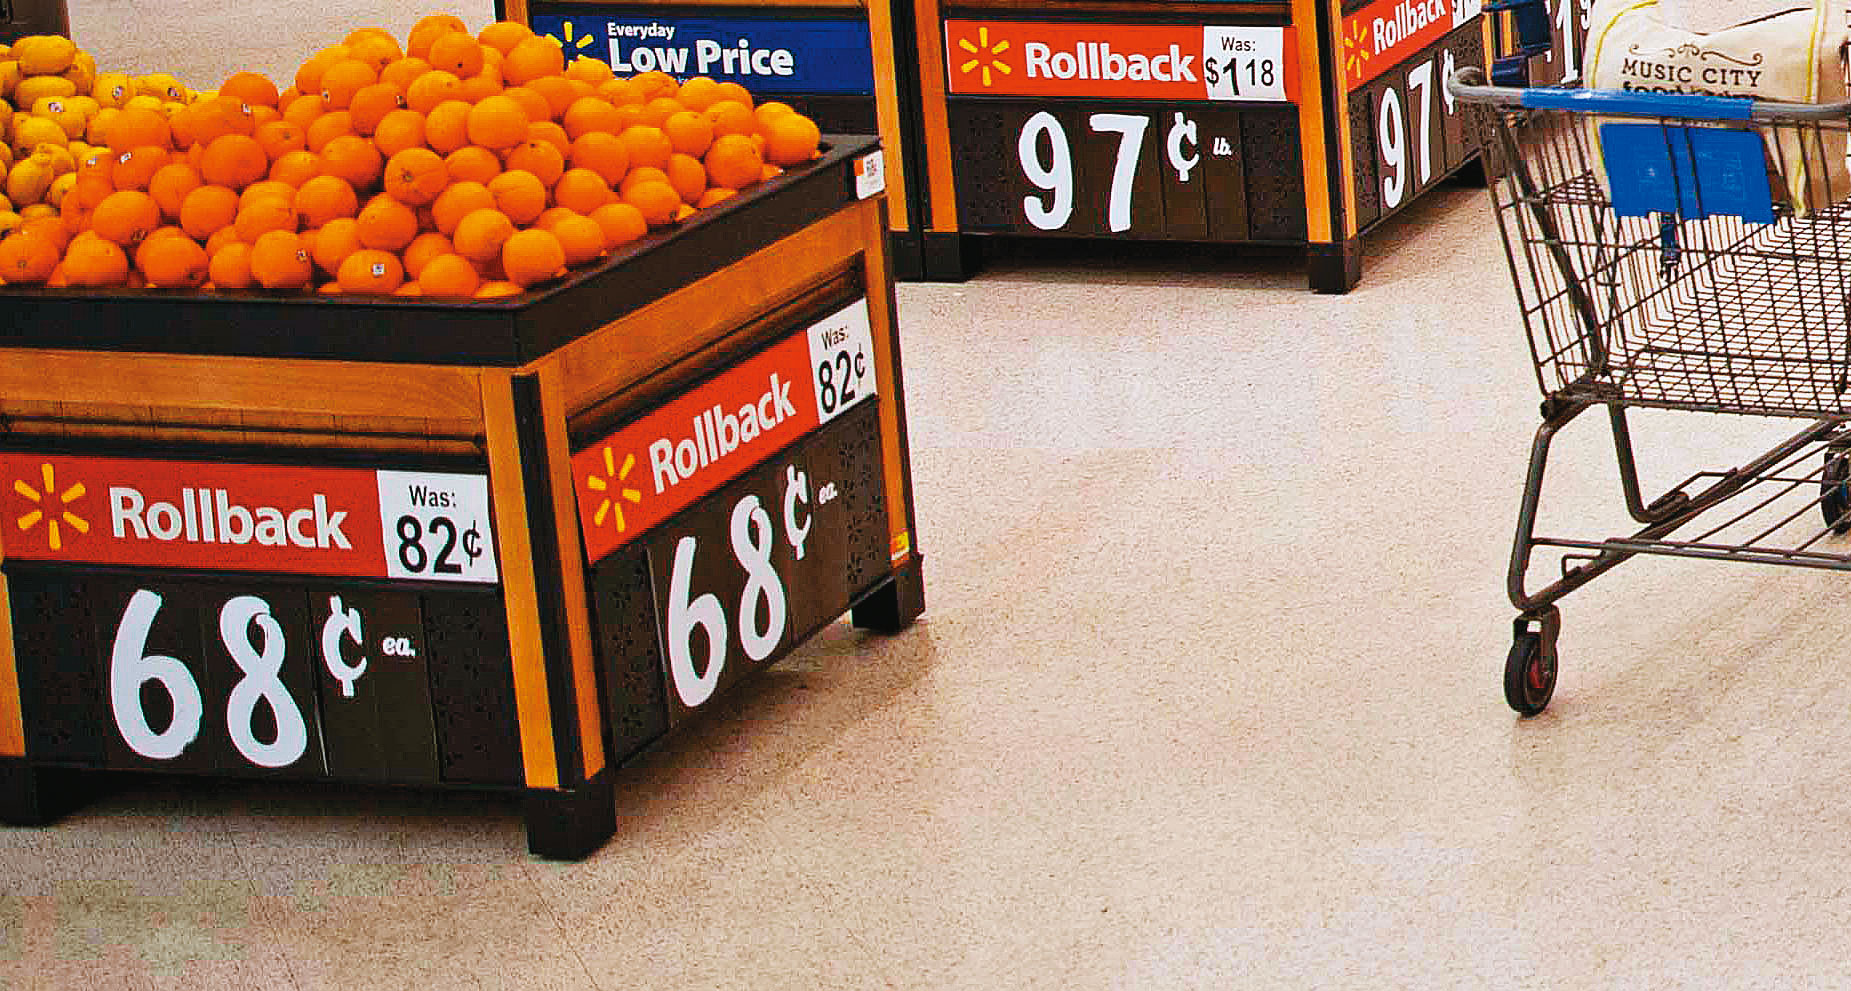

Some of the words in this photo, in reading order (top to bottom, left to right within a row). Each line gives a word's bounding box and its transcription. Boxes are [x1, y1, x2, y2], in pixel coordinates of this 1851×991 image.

[607, 22, 675, 40] Everyday
[1221, 36, 1256, 52] Was:
[608, 38, 689, 73] Low
[696, 38, 794, 75] Price
[1025, 42, 1197, 82] Rollback
[1205, 57, 1274, 96] $118
[1622, 58, 1692, 82] MUSIC
[1702, 68, 1762, 87] CITY
[1379, 48, 1456, 208] 97¢
[1018, 111, 1199, 232] 97¢
[821, 323, 849, 350] Was:
[818, 343, 865, 414] 82¢
[649, 373, 796, 495] Rollback
[109, 487, 352, 550] Rollback
[409, 485, 457, 508] Was:
[397, 516, 484, 575] 82¢
[668, 464, 812, 707] 68¢
[110, 589, 368, 767] 68¢
